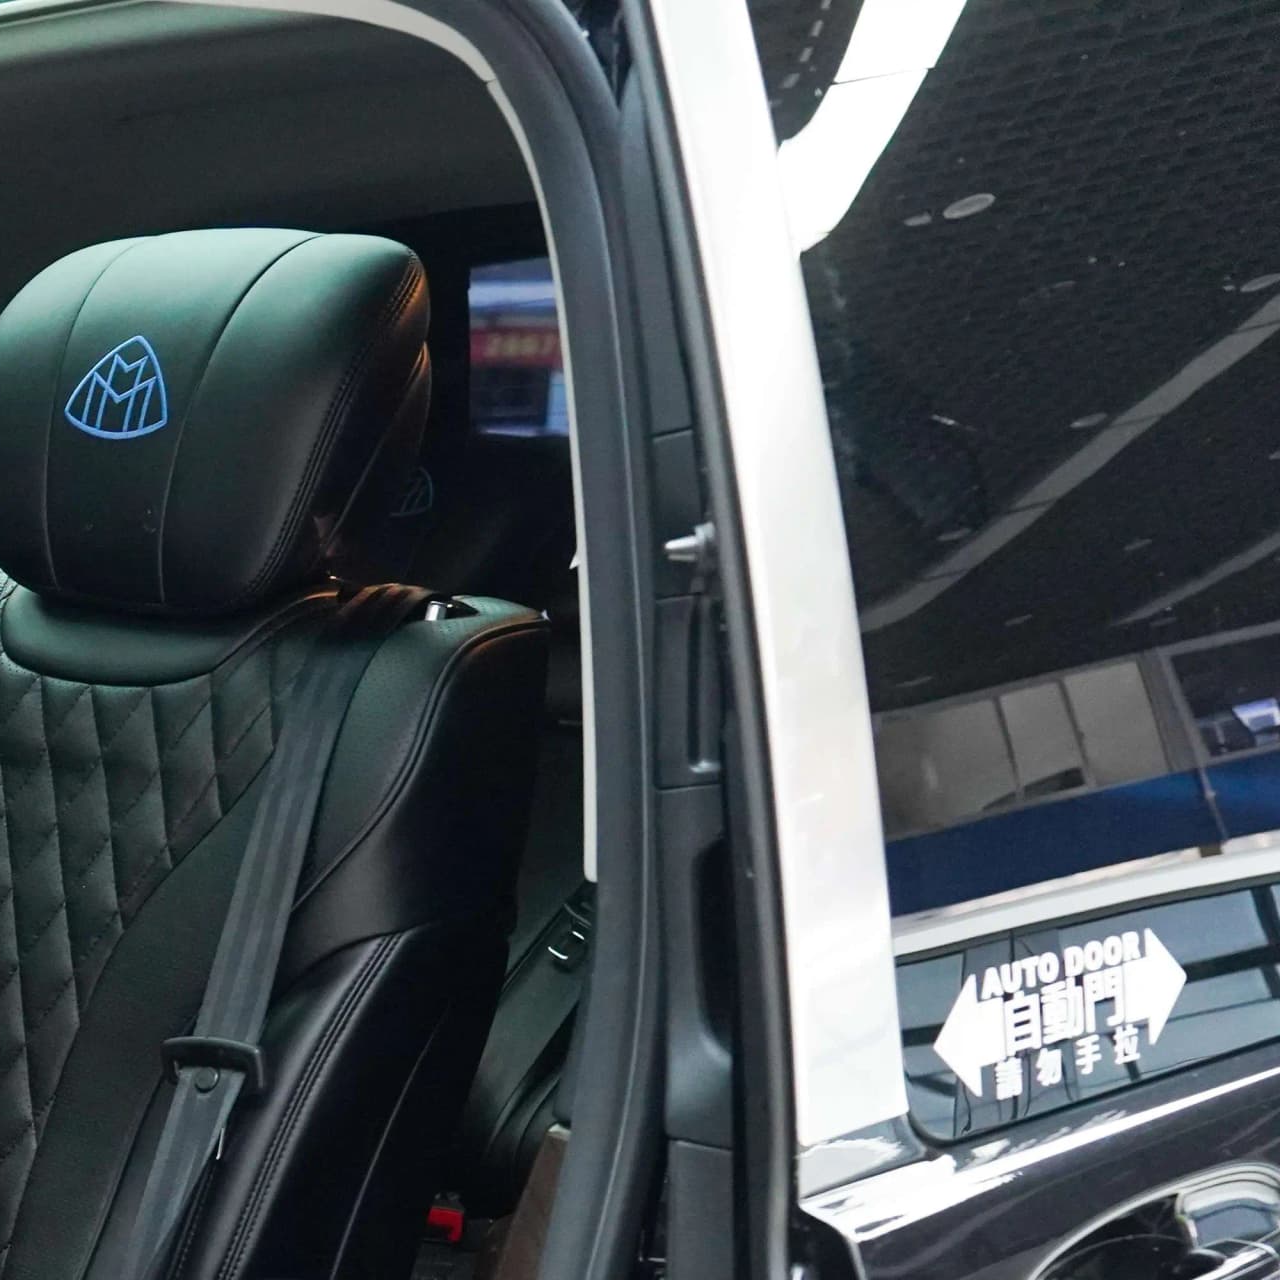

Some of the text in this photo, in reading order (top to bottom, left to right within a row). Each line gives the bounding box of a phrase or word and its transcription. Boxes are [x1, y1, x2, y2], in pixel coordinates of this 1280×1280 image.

[981, 931, 1142, 1000] AUTO DOOR
[1004, 963, 1125, 1056] 自動門
